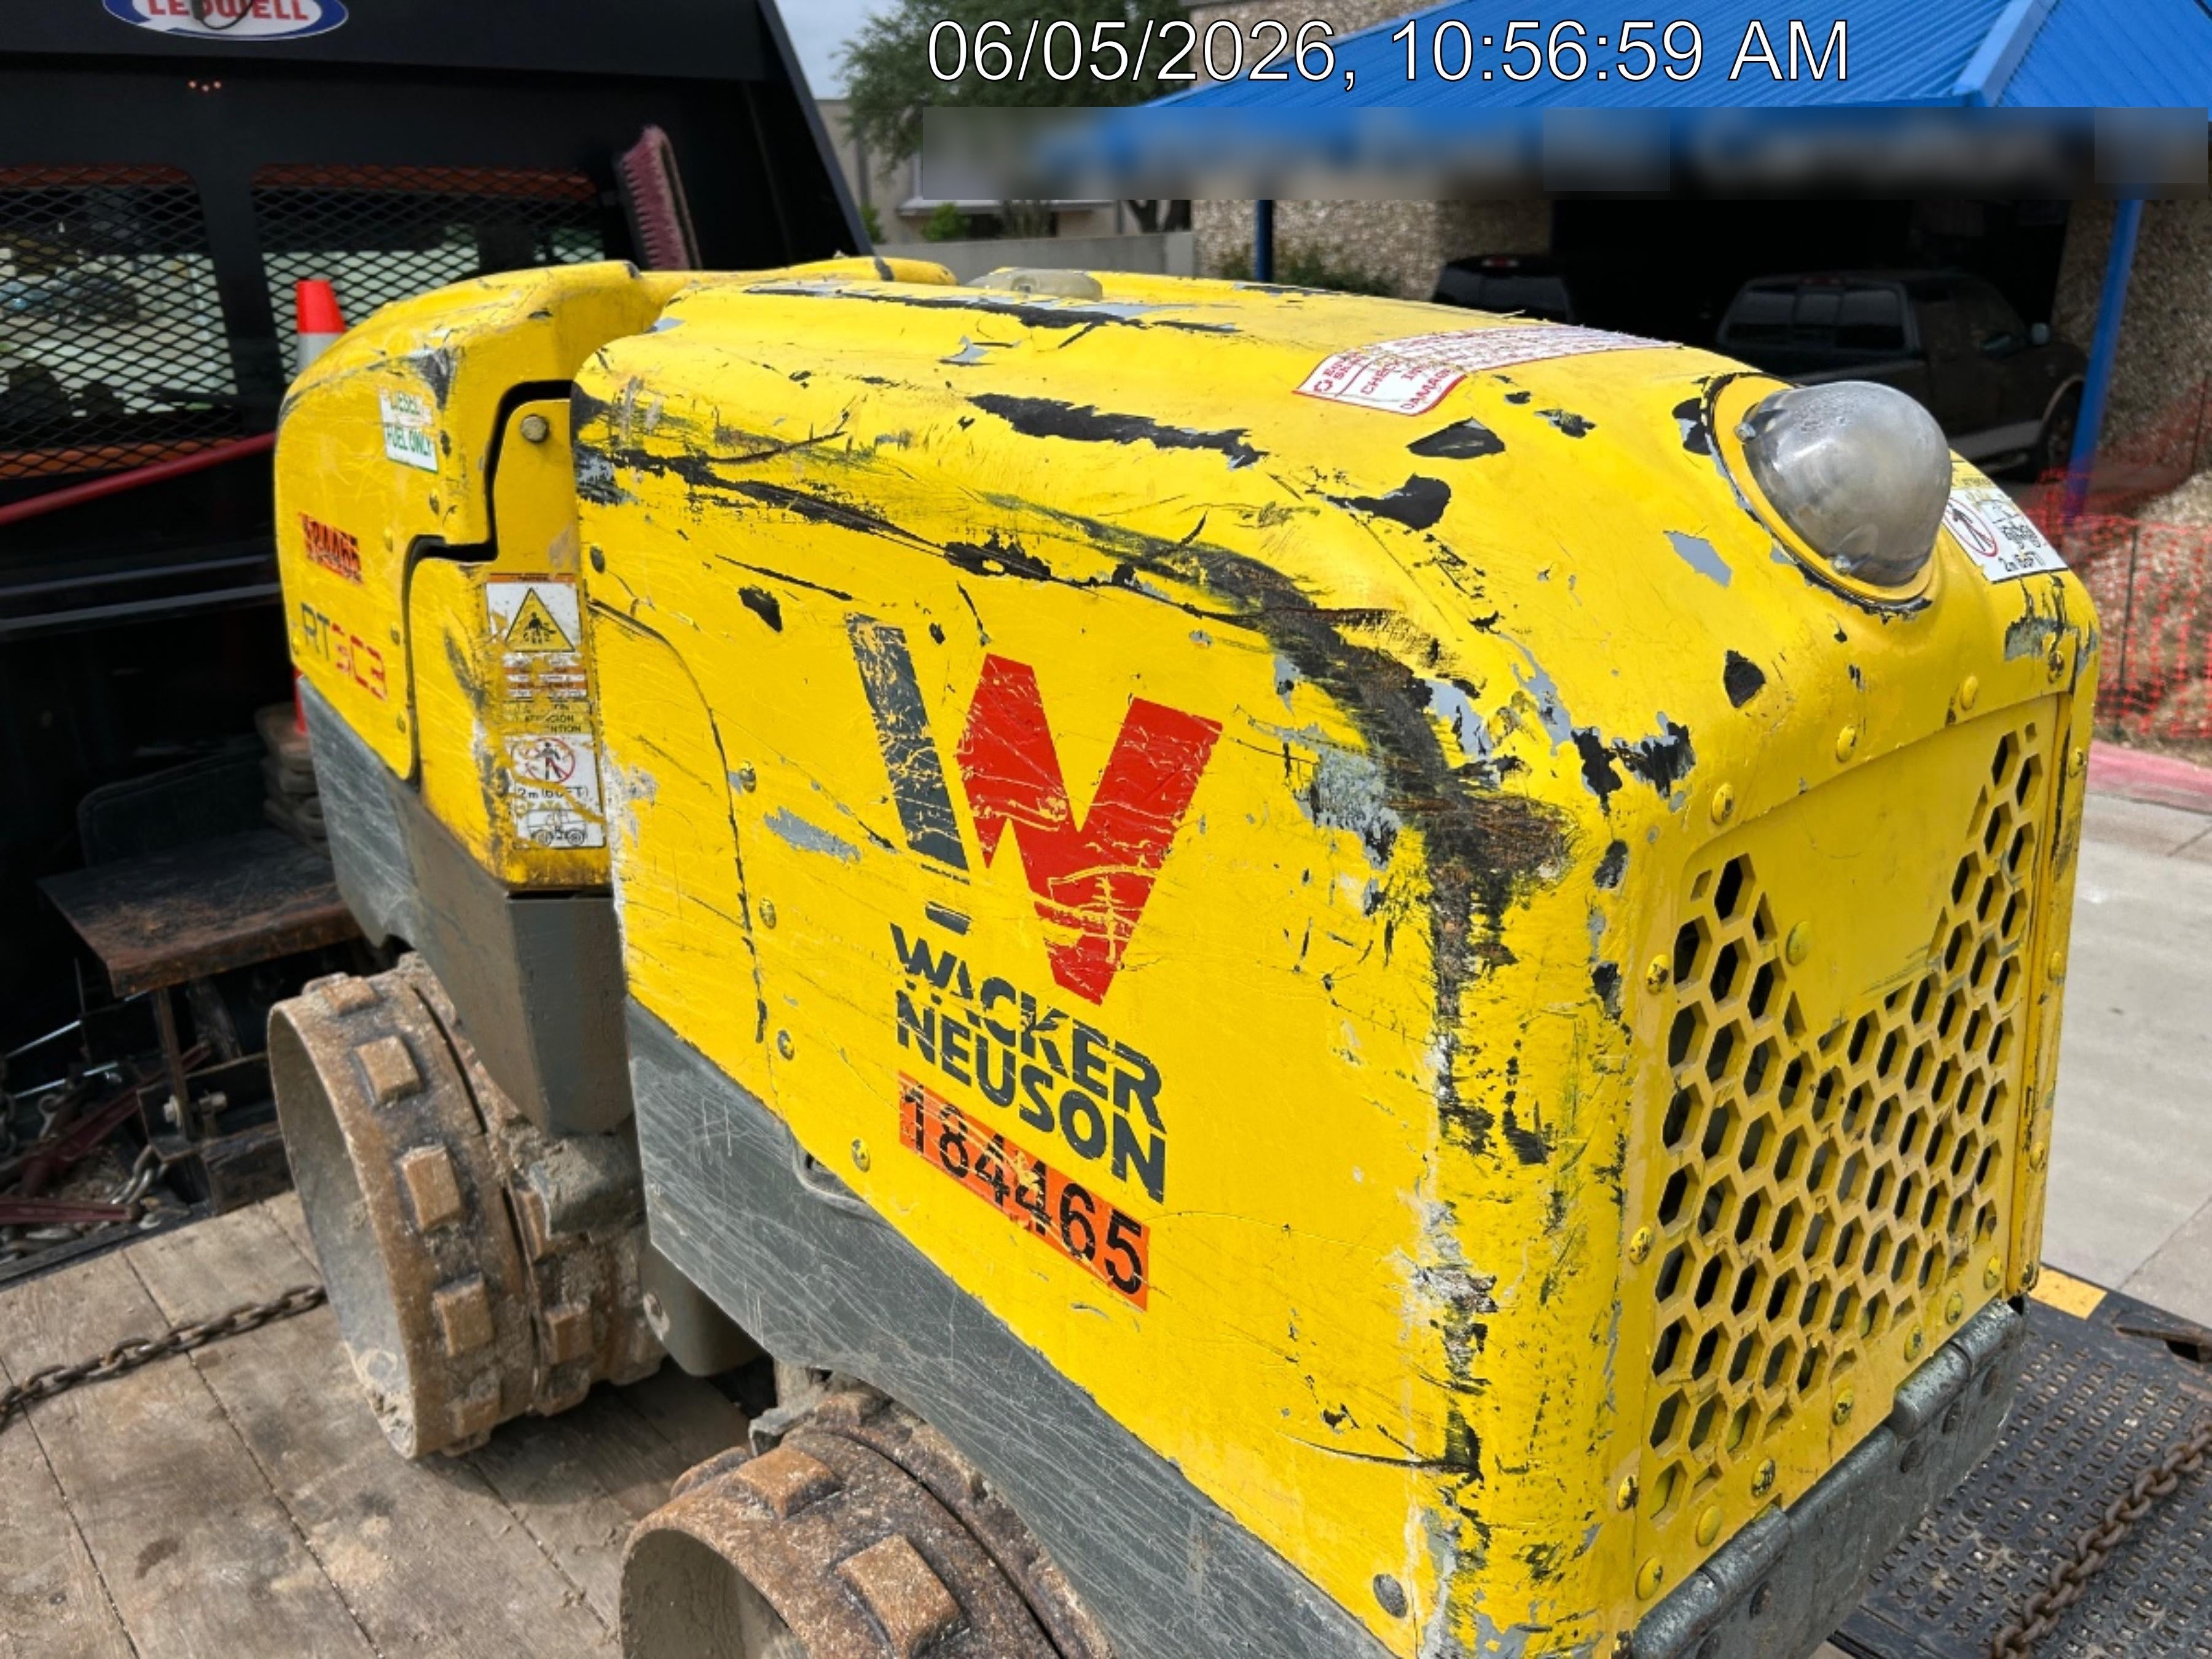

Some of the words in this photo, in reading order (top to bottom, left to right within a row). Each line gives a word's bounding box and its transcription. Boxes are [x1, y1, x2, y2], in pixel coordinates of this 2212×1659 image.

[890, 922, 1168, 1135] WACKER
[895, 990, 1167, 1206] NEUSON
[902, 1084, 1143, 1295] 184465
